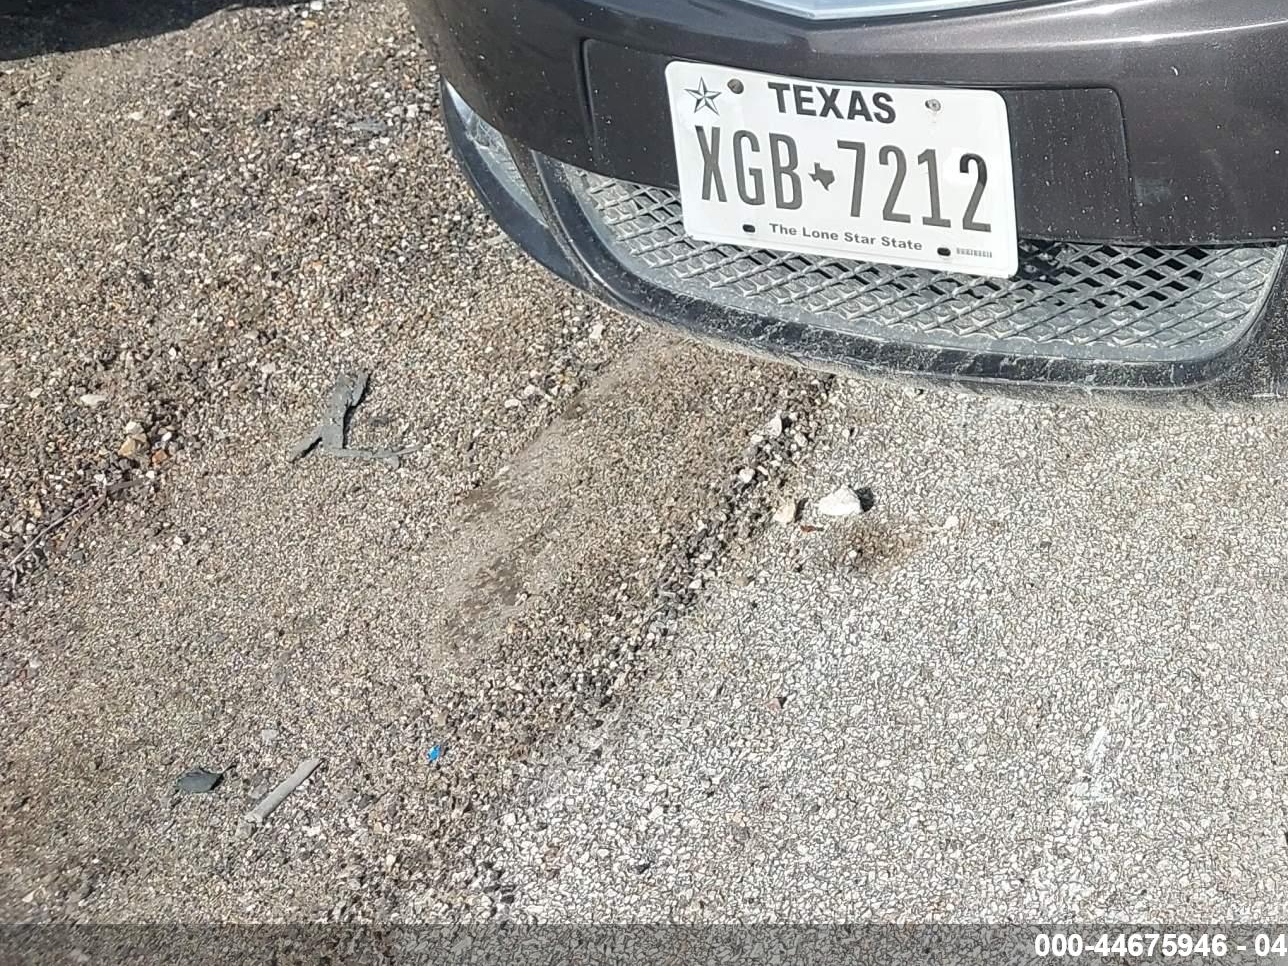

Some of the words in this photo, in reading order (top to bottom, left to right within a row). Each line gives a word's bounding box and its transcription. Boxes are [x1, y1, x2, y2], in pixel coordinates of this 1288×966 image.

[767, 82, 896, 124] TEXAS
[695, 125, 803, 210] XGB
[837, 140, 992, 233] 7212
[769, 223, 797, 236] The
[802, 226, 839, 241] Lone
[844, 232, 876, 245] Star
[881, 236, 923, 251] State
